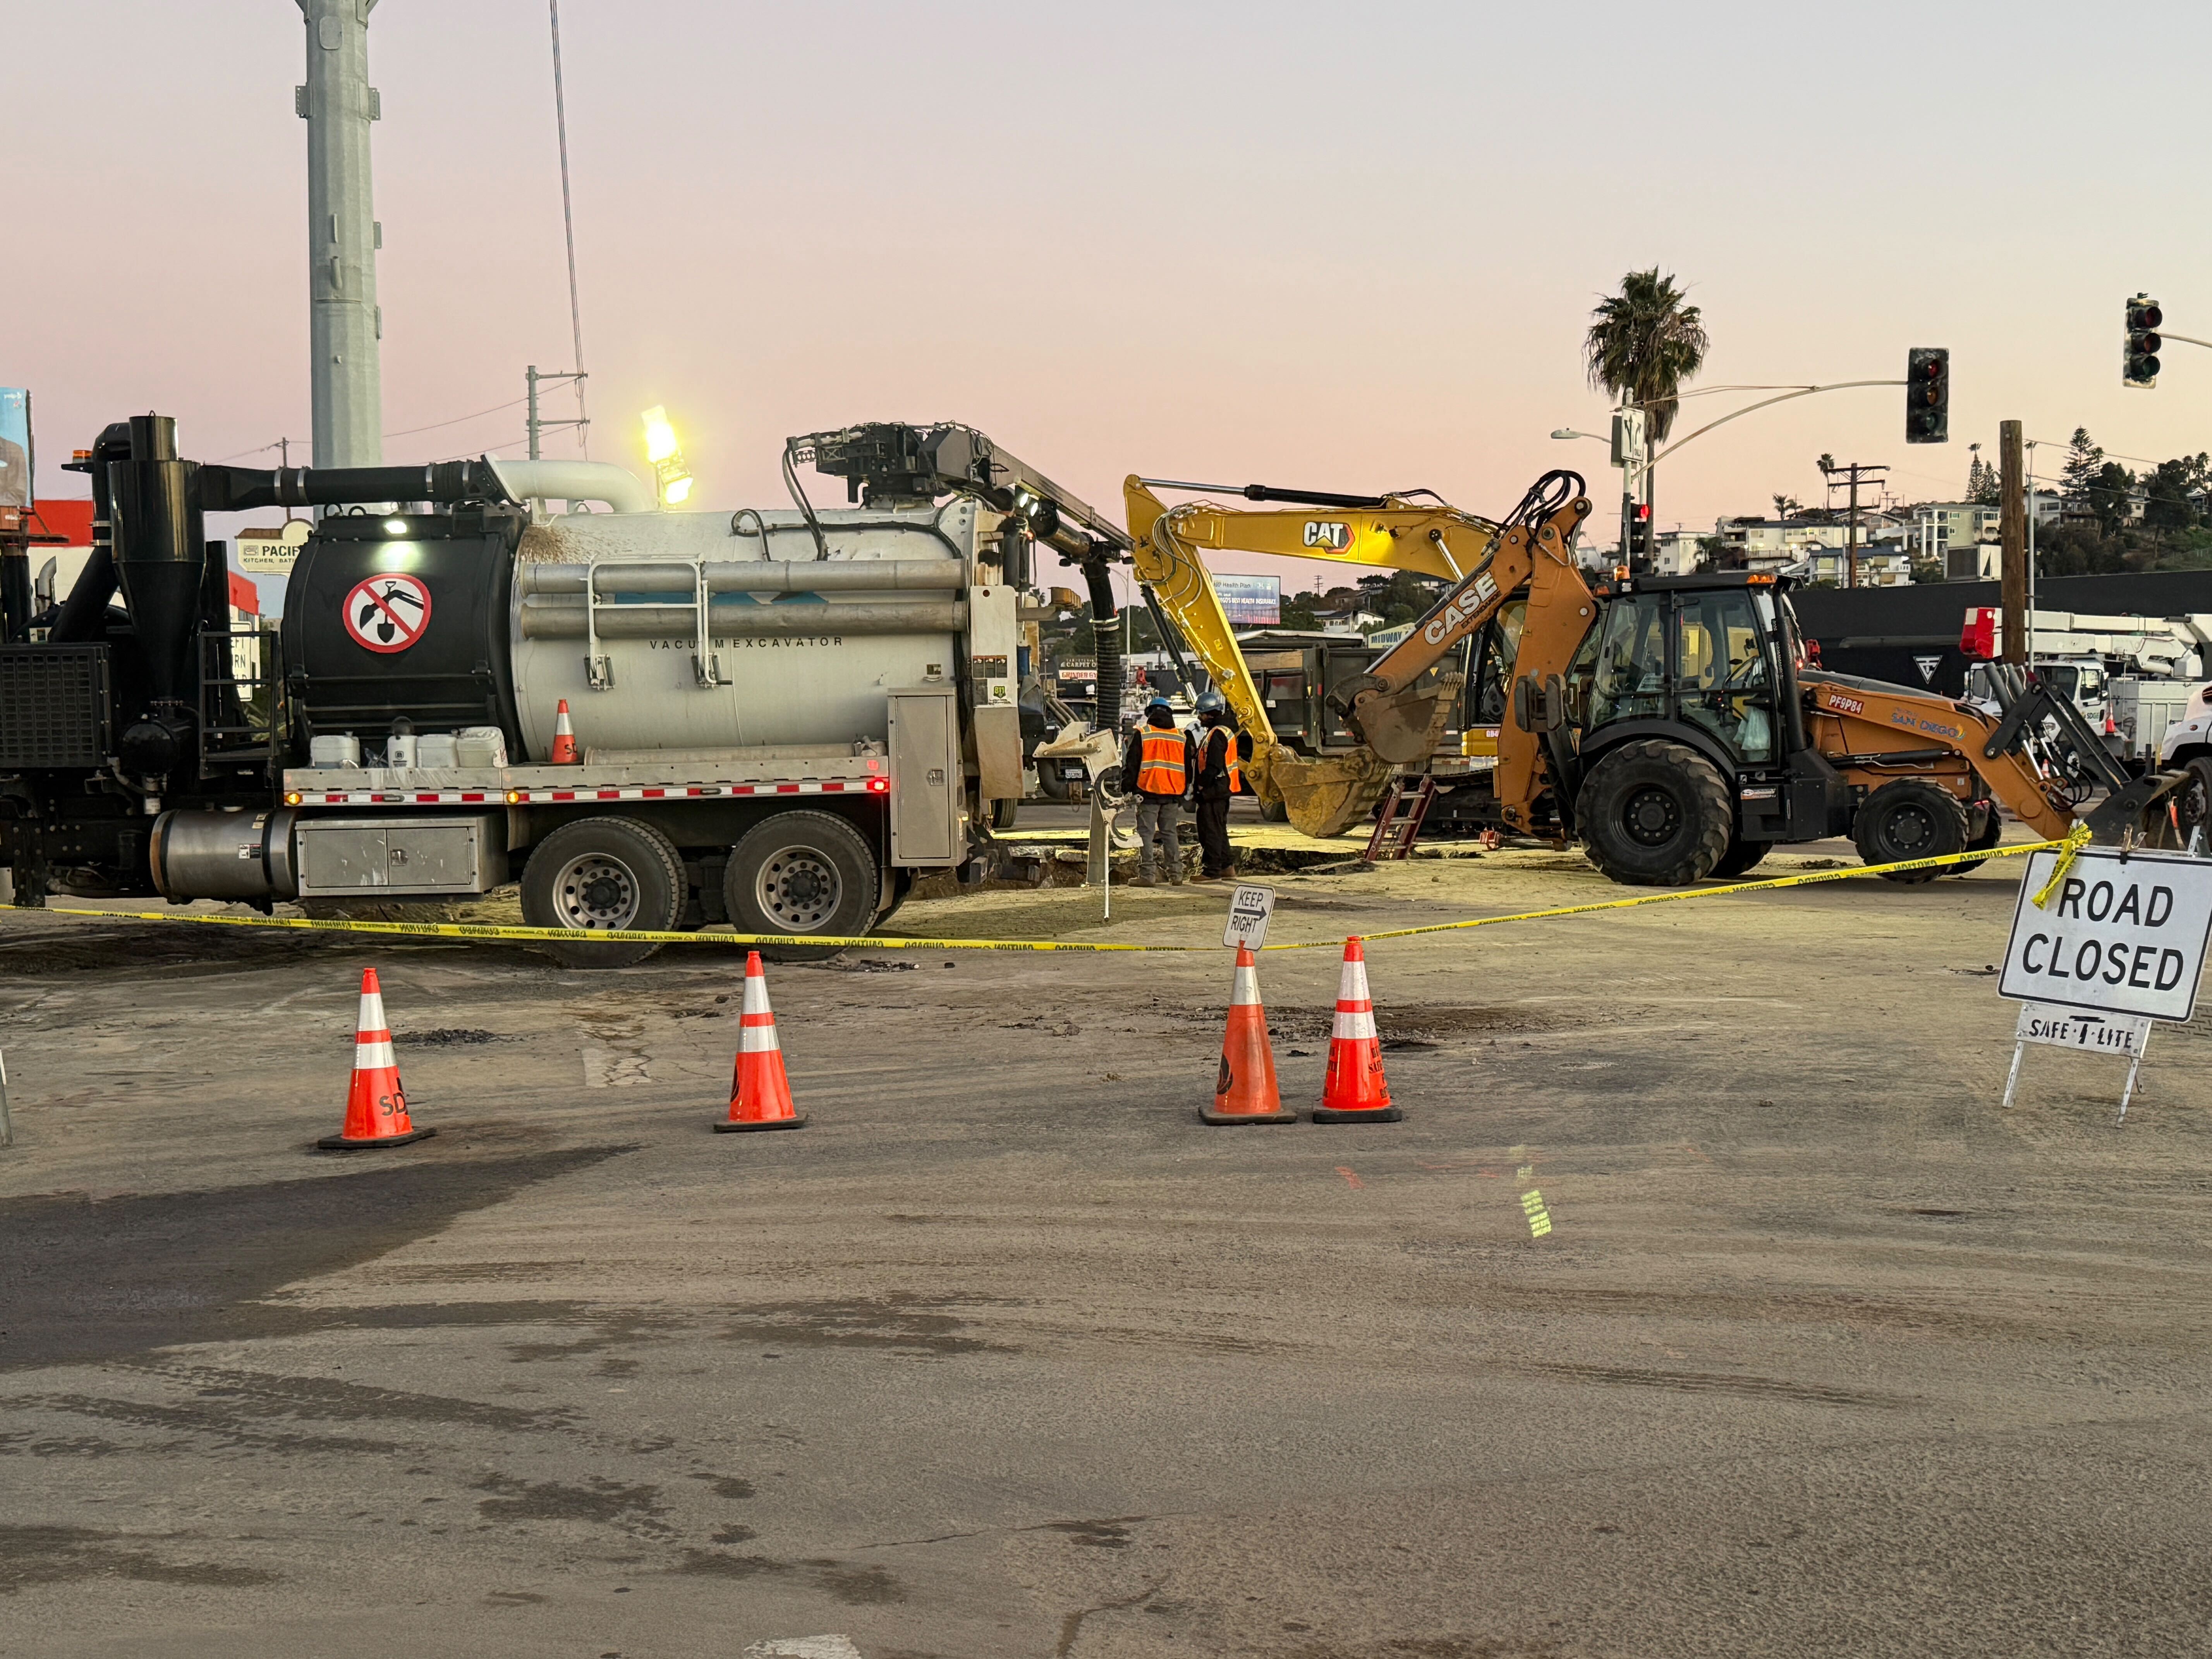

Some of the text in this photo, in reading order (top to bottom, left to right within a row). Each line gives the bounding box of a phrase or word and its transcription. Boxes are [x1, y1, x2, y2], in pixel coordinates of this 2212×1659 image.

[1304, 522, 1343, 547] CAT
[1424, 571, 1498, 645] CASE
[650, 637, 843, 651] VACUM EXCAVATOR
[1371, 631, 1402, 644] MIDWAY
[1829, 694, 1862, 713] PF9P84
[1891, 713, 1959, 738] SAN DIEGO
[1238, 890, 1264, 908] KEEP
[2057, 878, 2173, 927] ROAD
[1231, 915, 1259, 933] RIGHT
[2022, 933, 2184, 991] CLOSED
